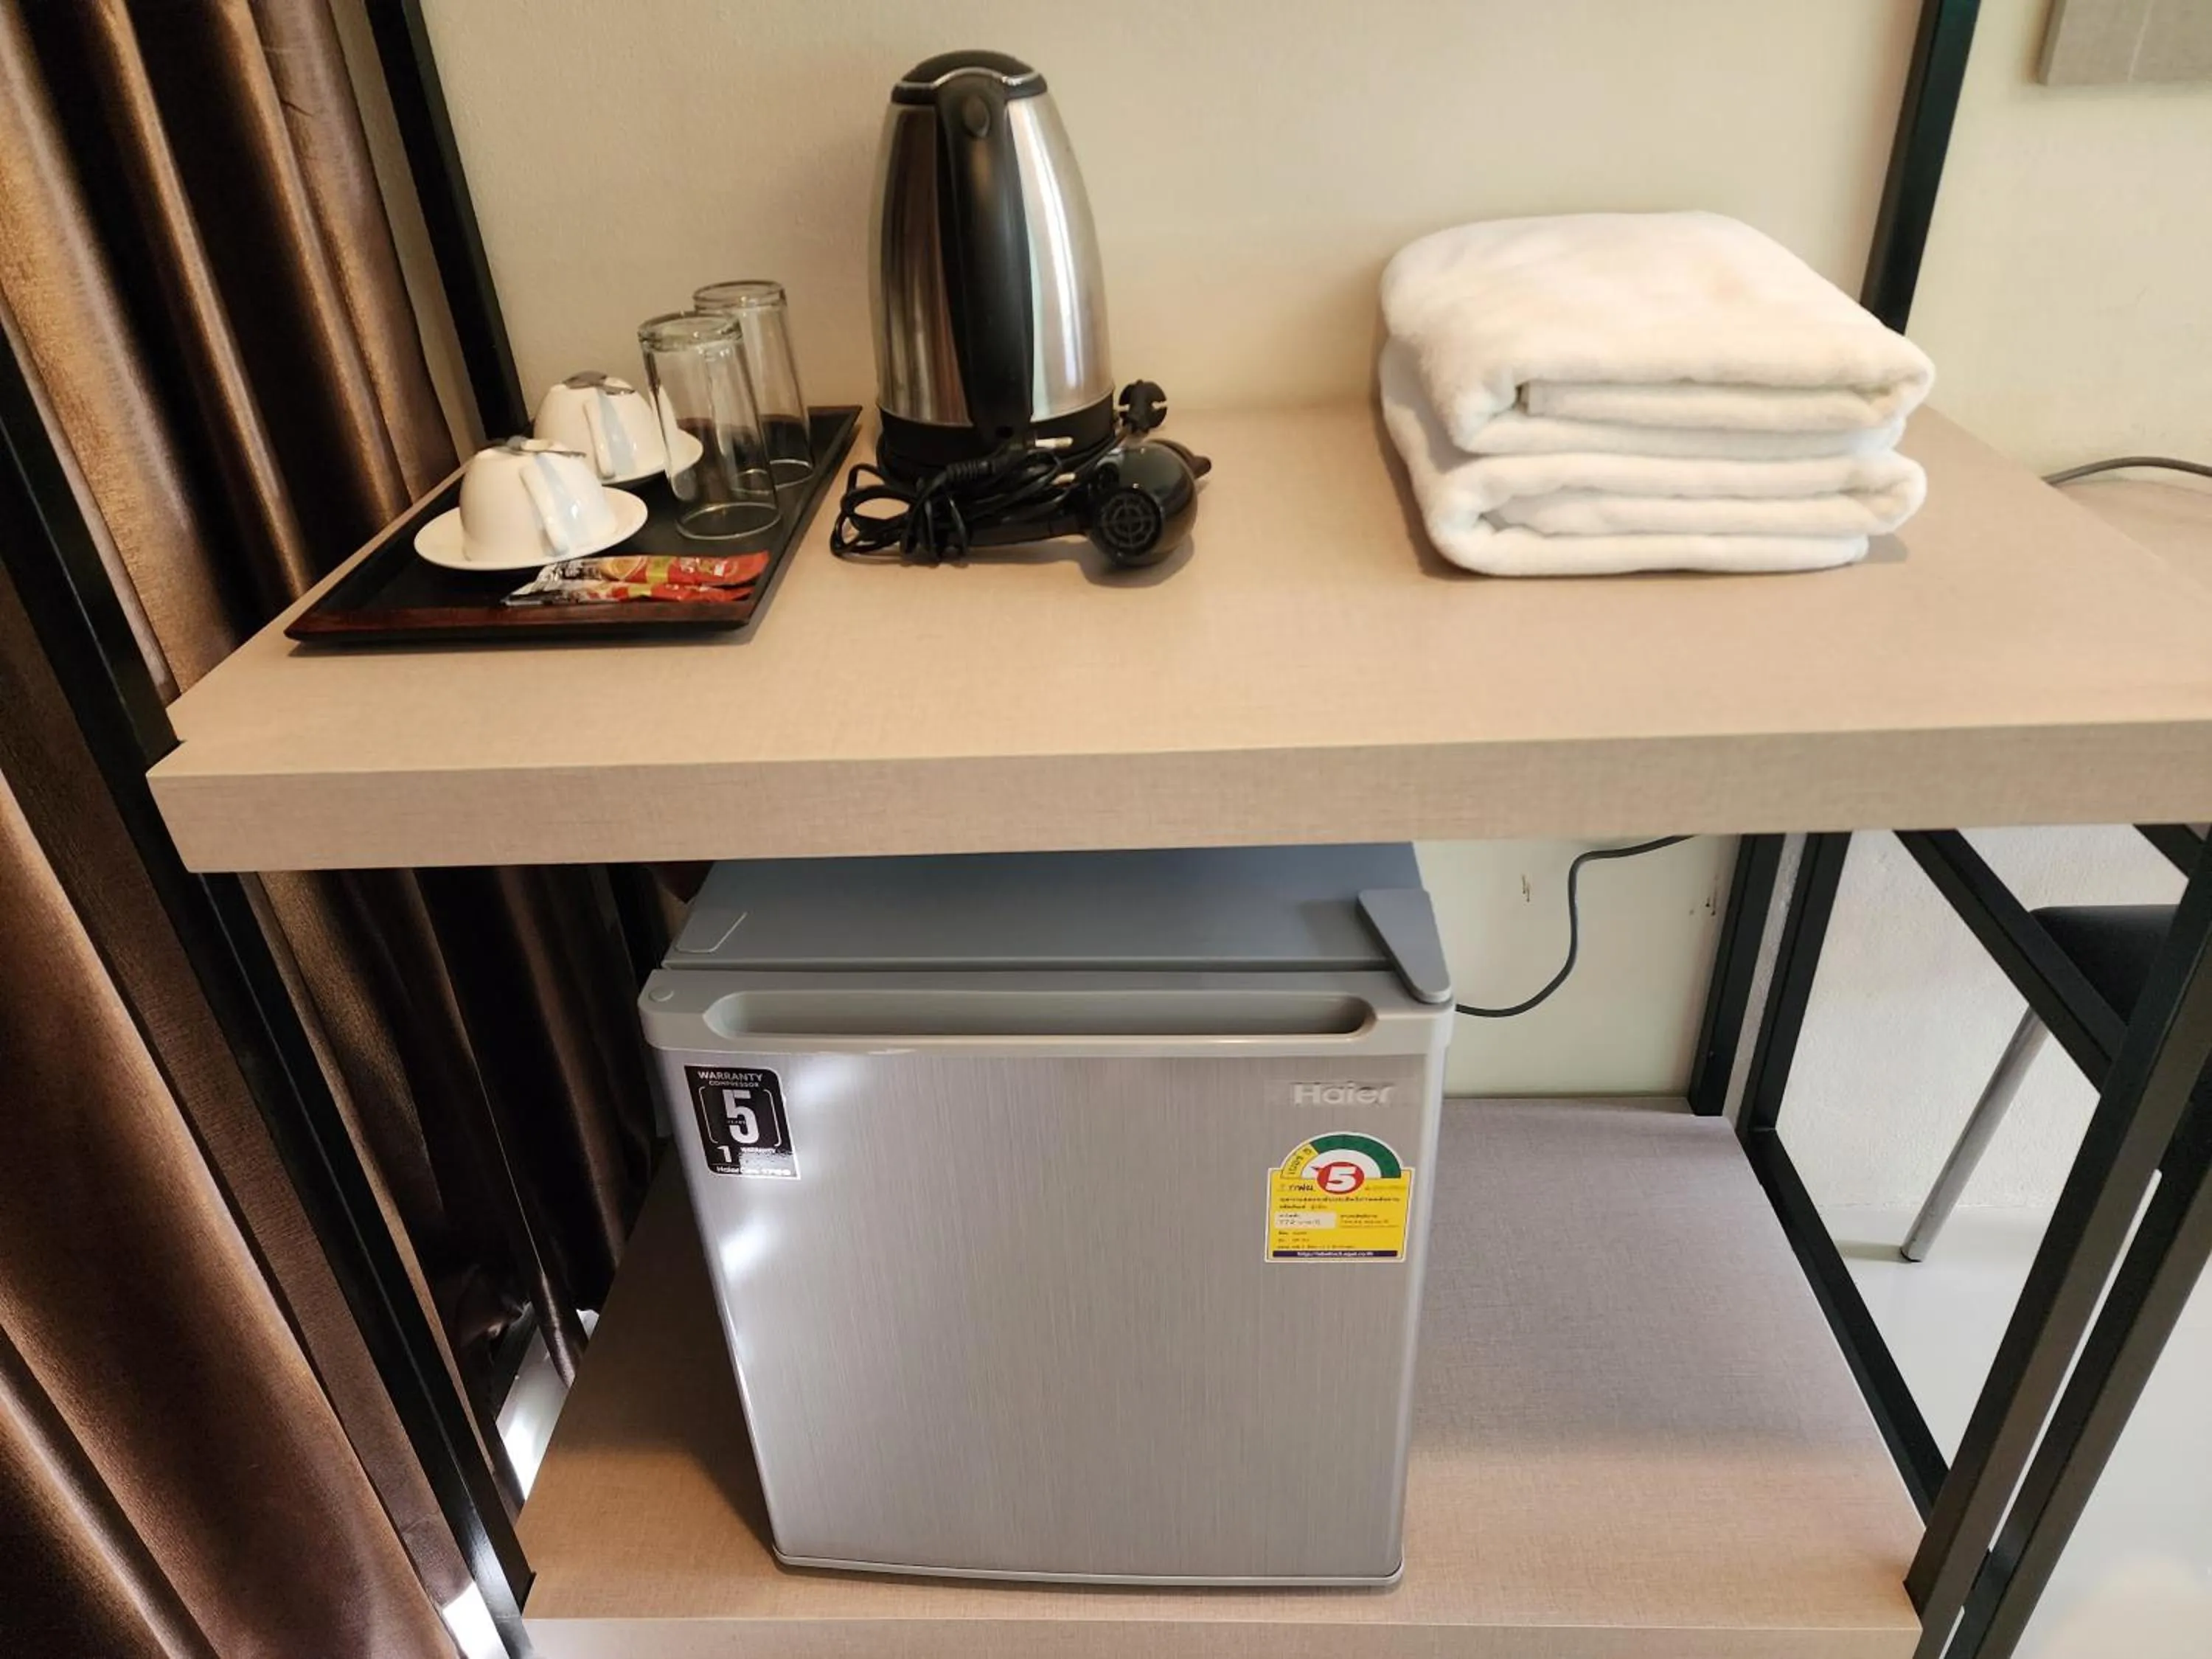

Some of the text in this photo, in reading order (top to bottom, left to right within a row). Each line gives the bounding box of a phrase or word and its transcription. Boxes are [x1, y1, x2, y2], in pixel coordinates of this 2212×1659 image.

[698, 1071, 763, 1082] WARRANTY
[1293, 1081, 1396, 1105] Haier
[722, 1088, 759, 1144] 5
[717, 1145, 732, 1163] 1
[1324, 1165, 1357, 1193] 5
